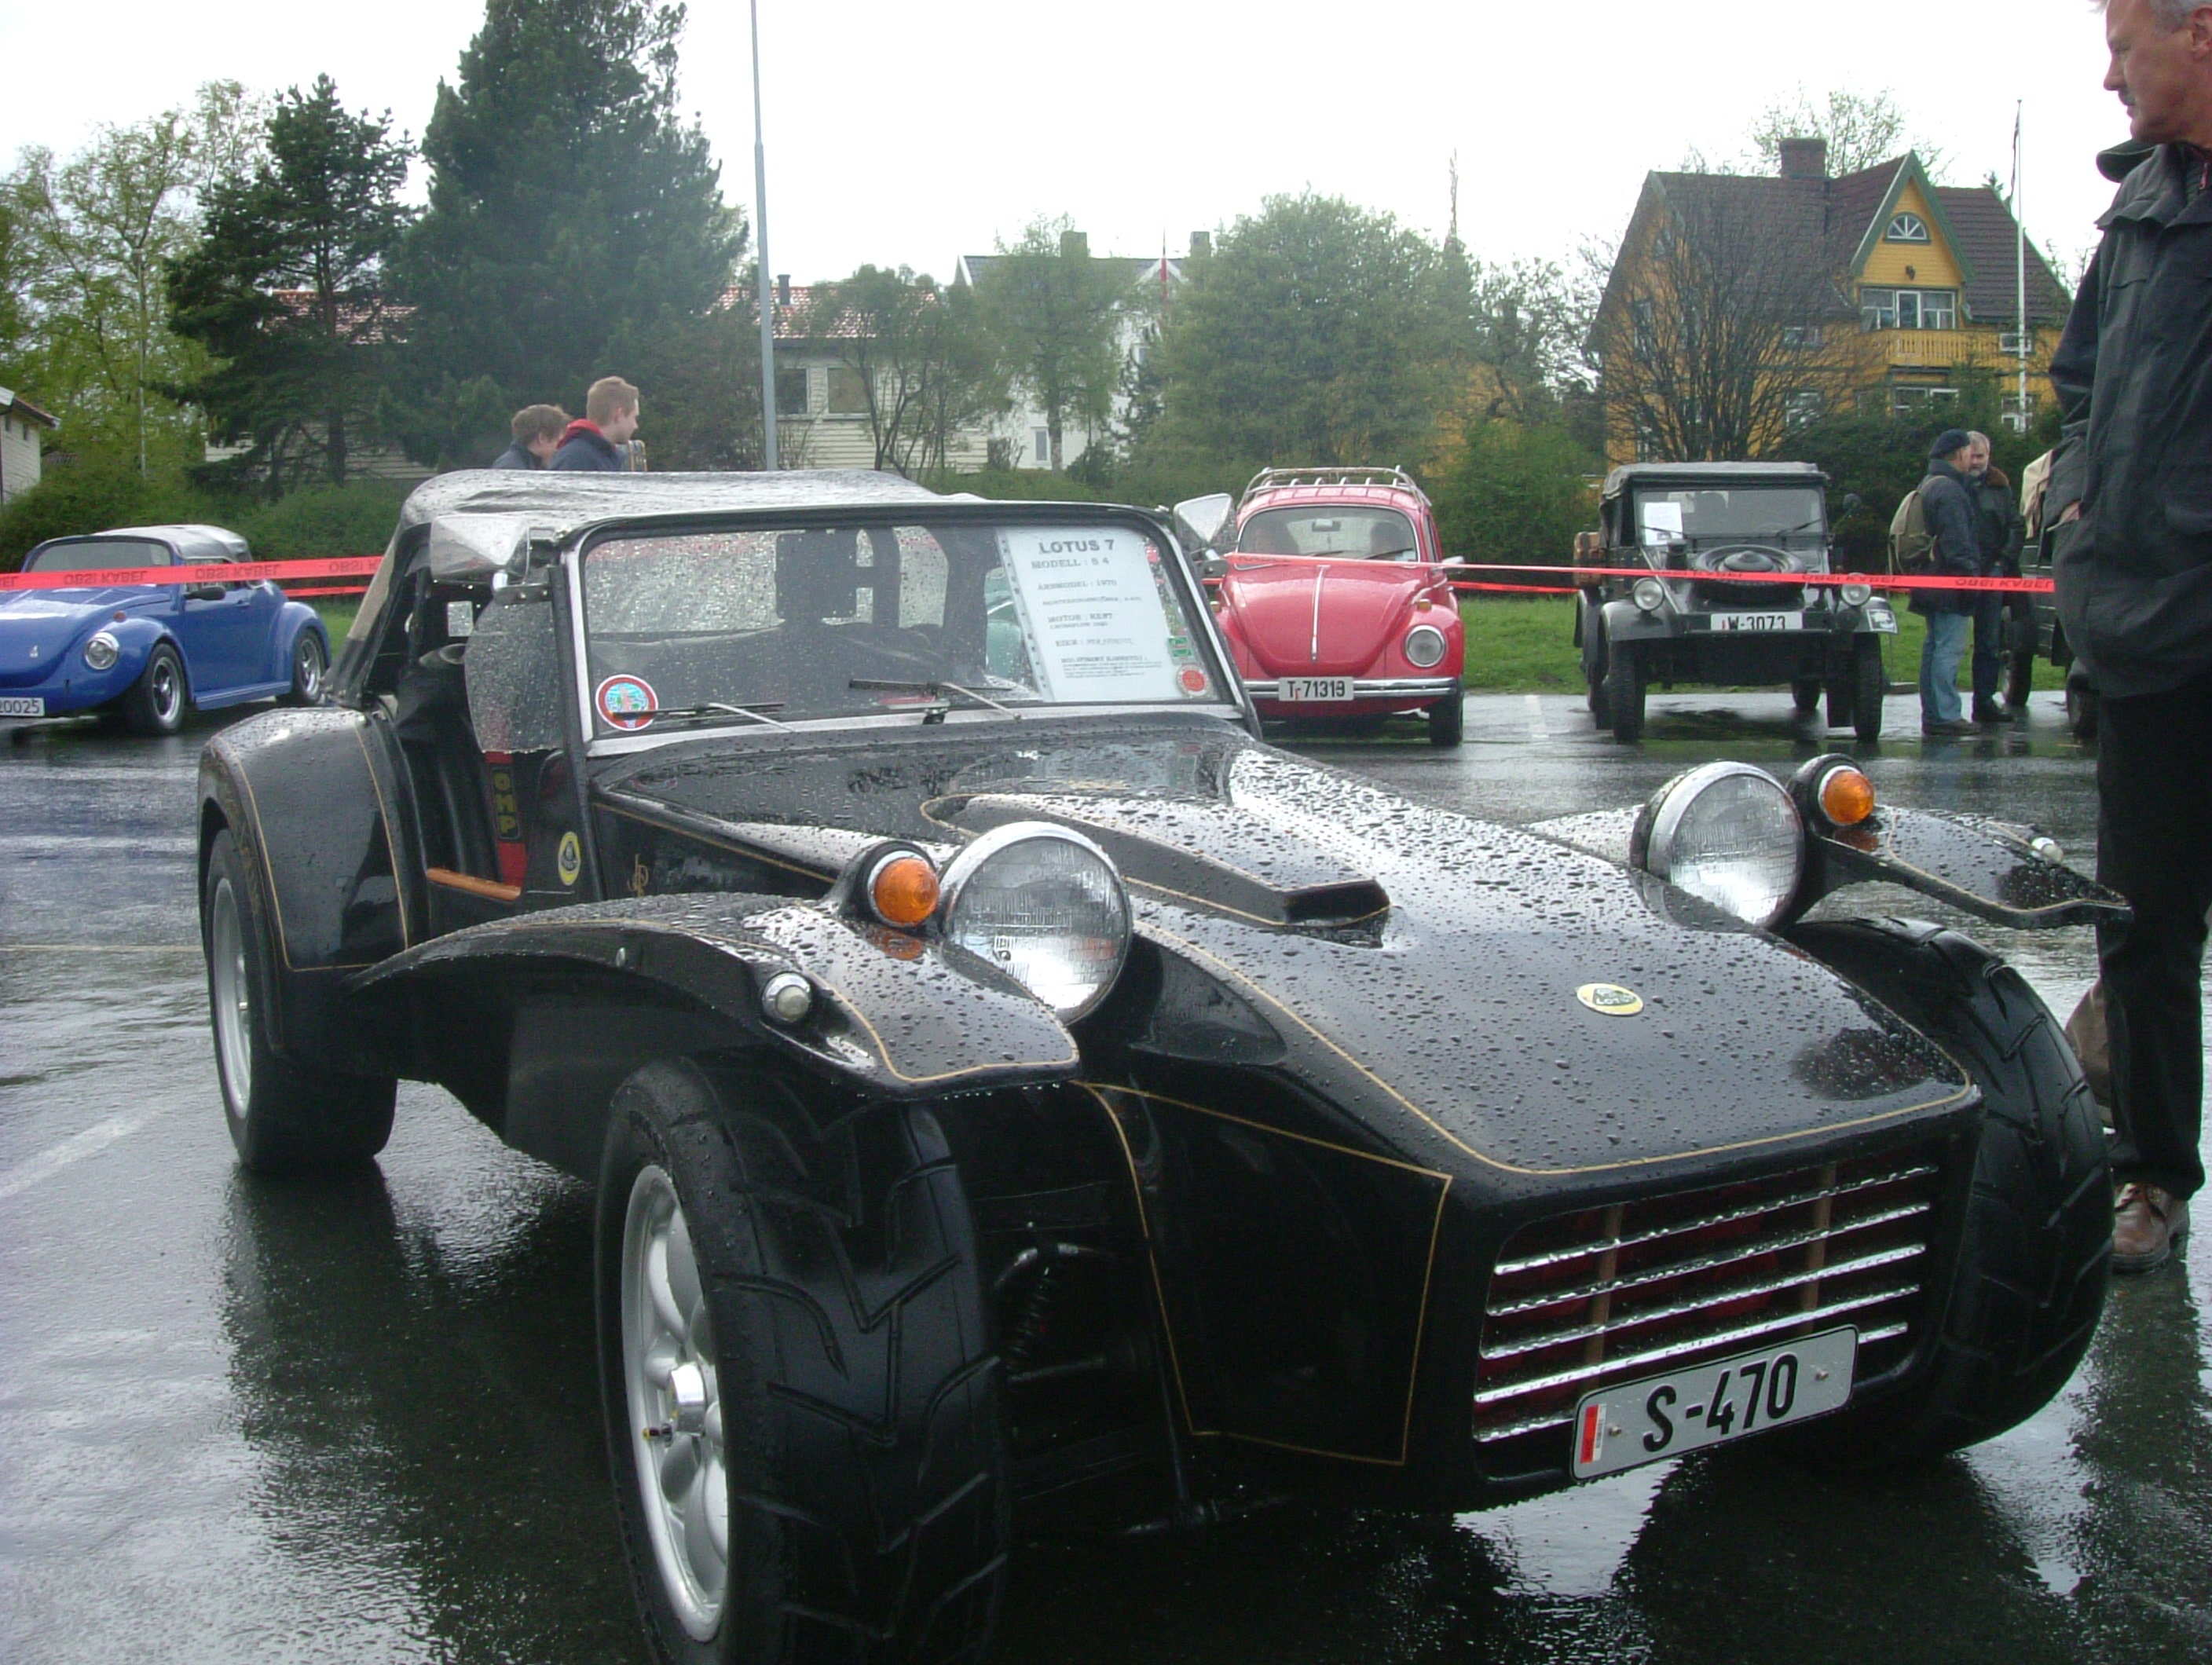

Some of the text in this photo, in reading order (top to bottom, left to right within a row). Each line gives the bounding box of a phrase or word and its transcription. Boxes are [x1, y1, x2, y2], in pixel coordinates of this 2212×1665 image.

[1038, 539, 1114, 554] LOTUS 7
[1031, 558, 1081, 569] MODELL
[1727, 616, 1785, 630] W-3073
[0, 699, 39, 714] 0025
[1643, 1352, 1799, 1453] S-470
